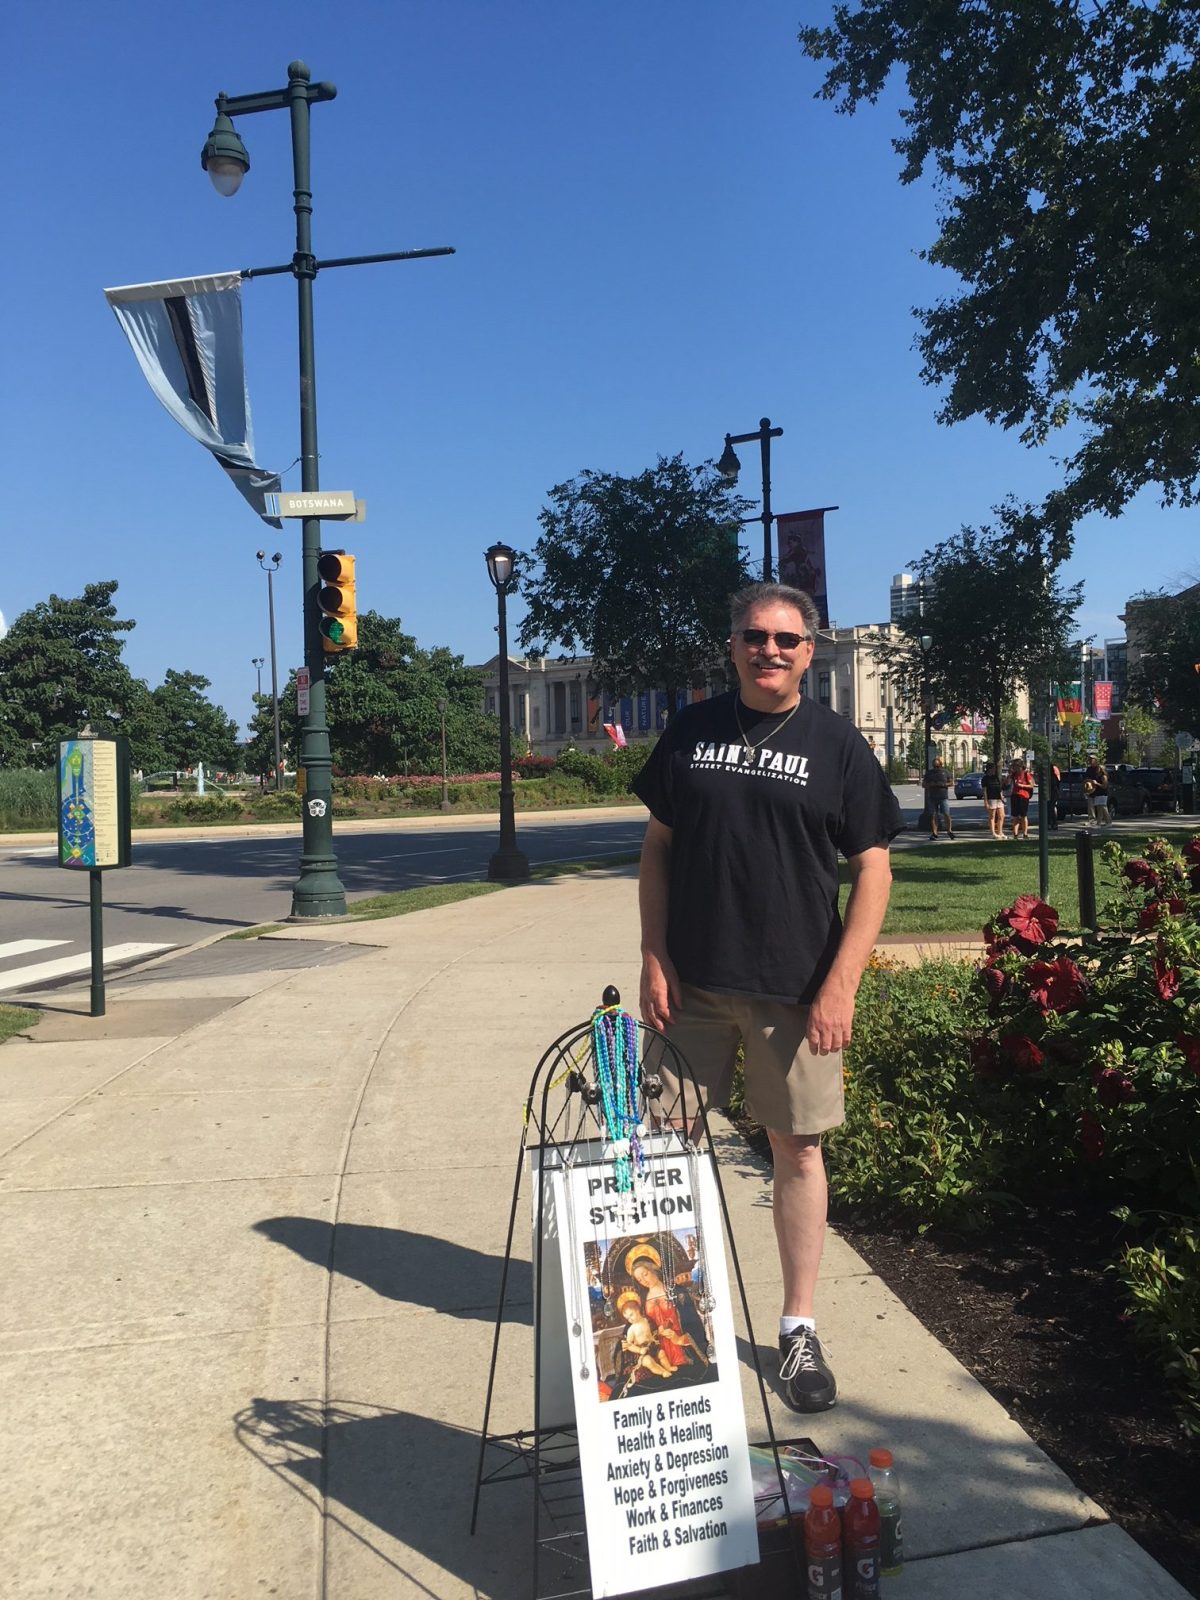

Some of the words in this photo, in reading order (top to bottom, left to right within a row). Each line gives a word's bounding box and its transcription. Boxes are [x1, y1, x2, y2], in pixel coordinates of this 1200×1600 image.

[289, 498, 344, 509] BOTSWANA
[725, 764, 807, 787] EVANGELIZATION
[757, 748, 809, 779] PAUL
[613, 1406, 652, 1430] Family
[656, 1403, 665, 1422] &
[668, 1395, 712, 1420] Friends
[617, 1430, 656, 1454] Health
[659, 1427, 667, 1446] &
[670, 1421, 713, 1444] Healing
[607, 1457, 651, 1482] Anxiety
[654, 1453, 663, 1472] &
[666, 1443, 729, 1472] Depression
[614, 1486, 645, 1507] Hope
[648, 1480, 657, 1499] &
[660, 1469, 728, 1498] Forgiveness
[626, 1505, 657, 1528] Work
[660, 1503, 669, 1522] &
[672, 1495, 723, 1519] Finances
[629, 1532, 659, 1555] Faith
[662, 1529, 671, 1548] &
[674, 1520, 728, 1546] Salvation
[808, 1565, 824, 1586] G
[857, 1558, 874, 1579] G
